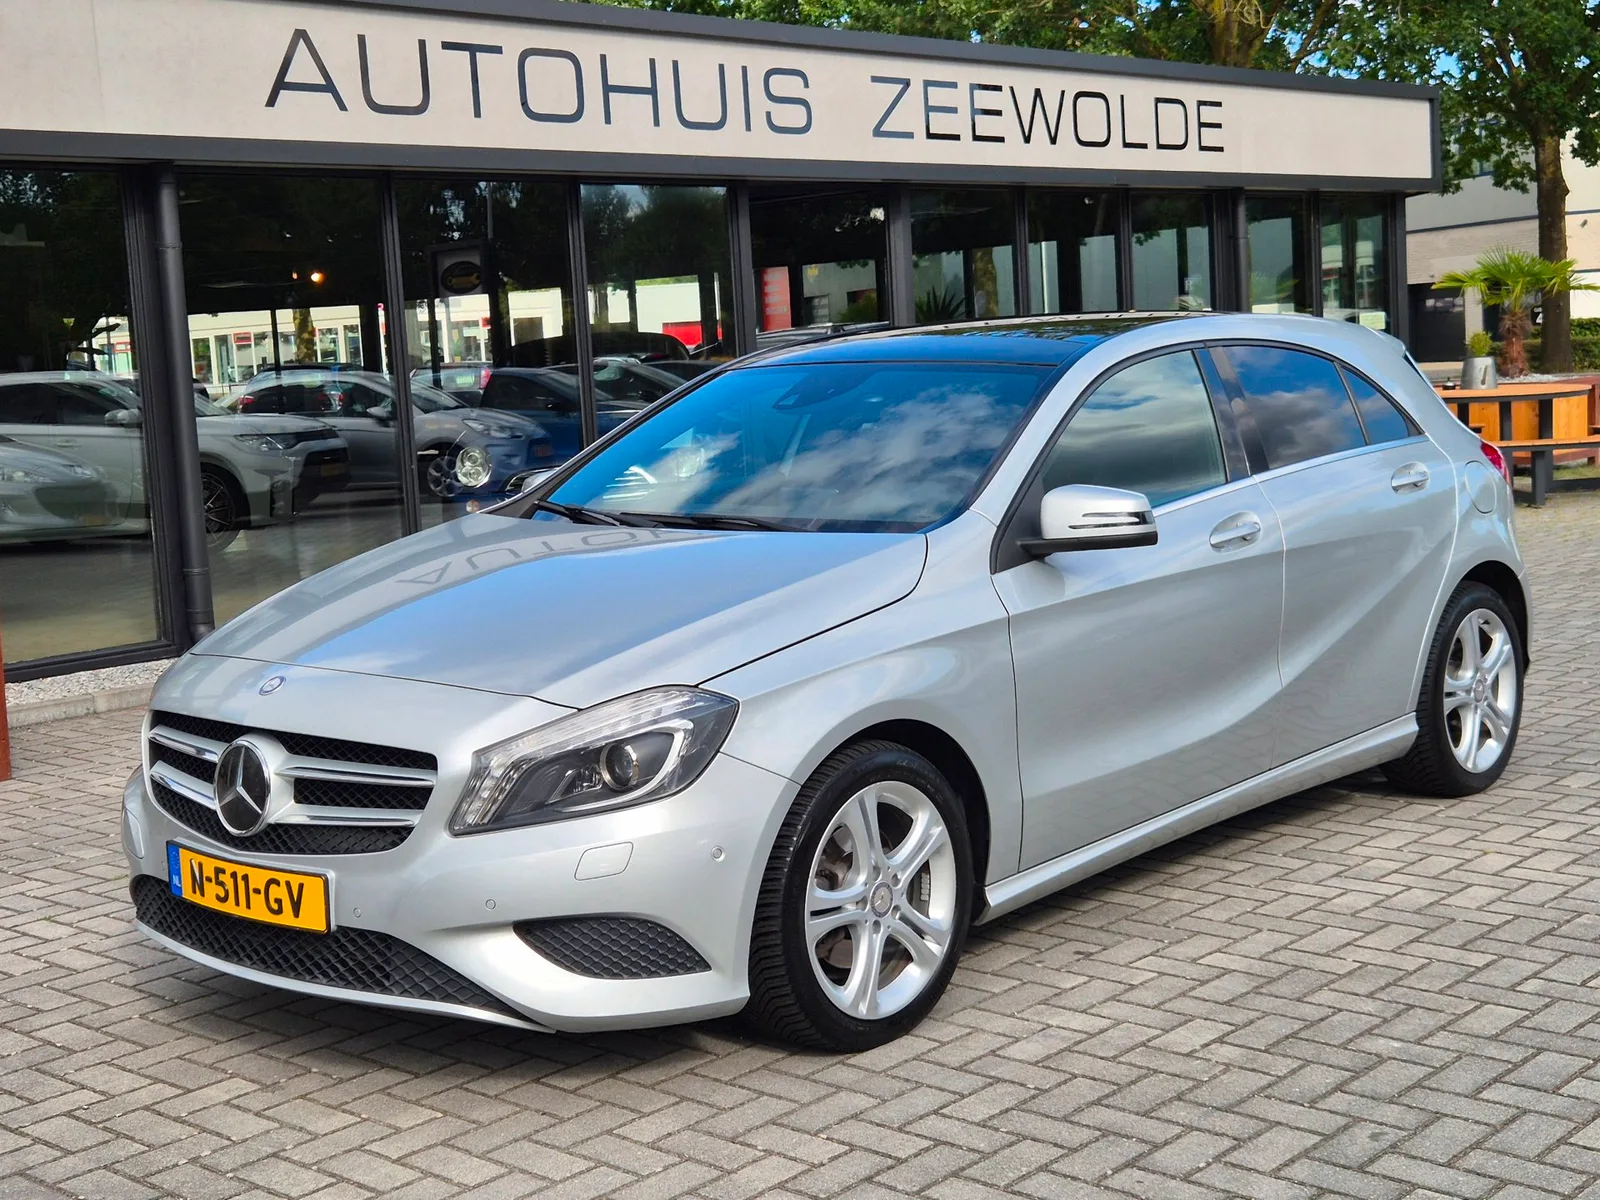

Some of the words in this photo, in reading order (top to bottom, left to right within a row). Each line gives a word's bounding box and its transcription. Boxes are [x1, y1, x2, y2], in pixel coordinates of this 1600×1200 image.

[266, 27, 813, 135] AUTOHUIS
[870, 75, 1225, 153] ZEEWOLDE
[172, 874, 182, 888] NL
[189, 858, 305, 919] N-511-GV
